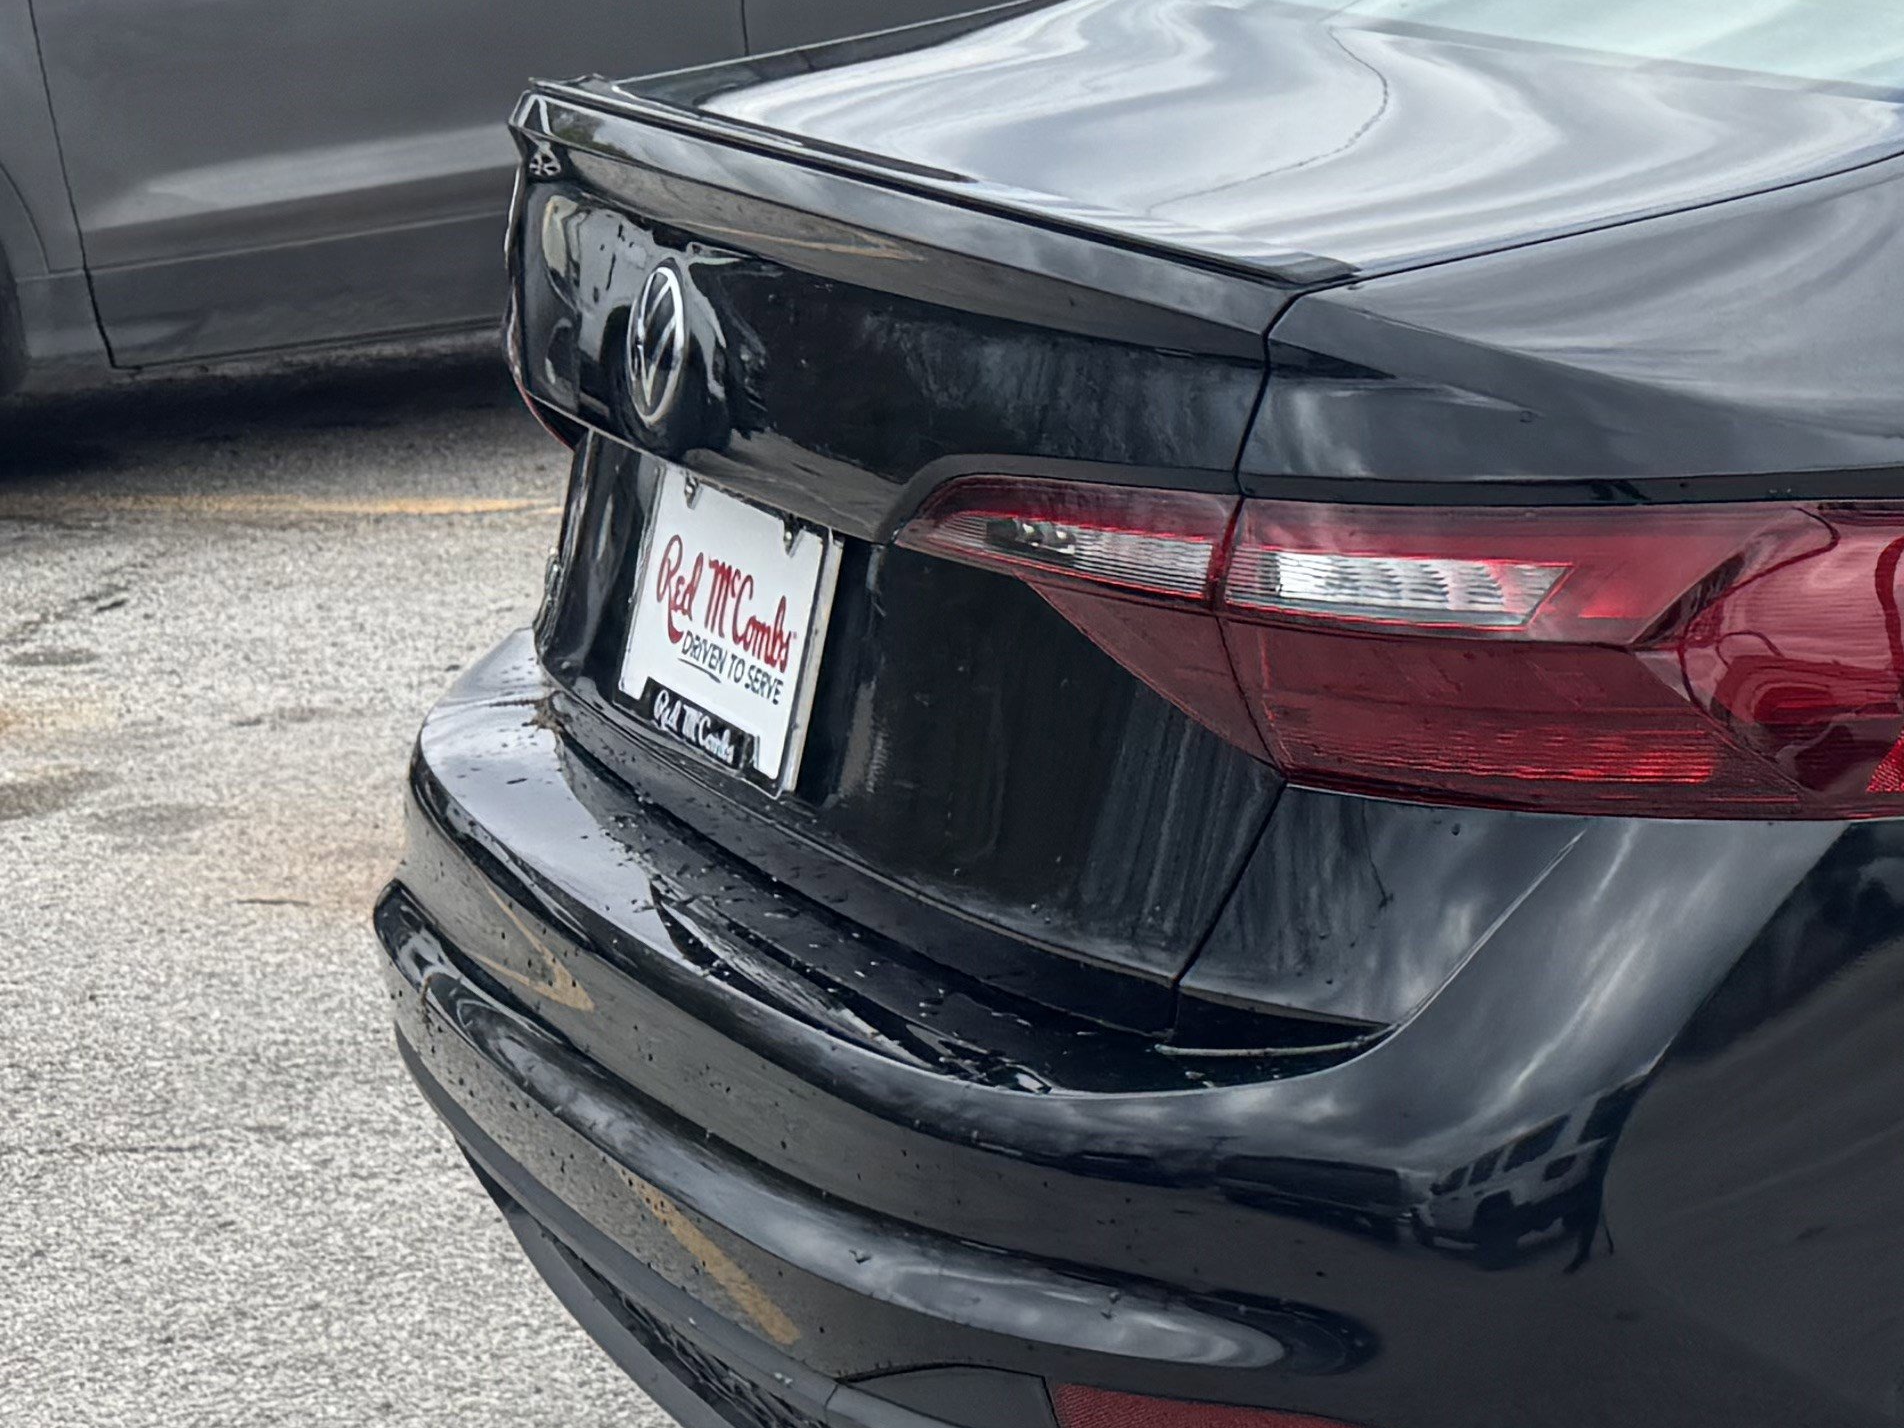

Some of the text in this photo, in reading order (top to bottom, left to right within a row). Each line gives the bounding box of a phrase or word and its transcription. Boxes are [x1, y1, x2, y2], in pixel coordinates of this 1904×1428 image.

[656, 534, 790, 674] Red McCombs
[681, 630, 784, 706] DRIVEN TO SERVE
